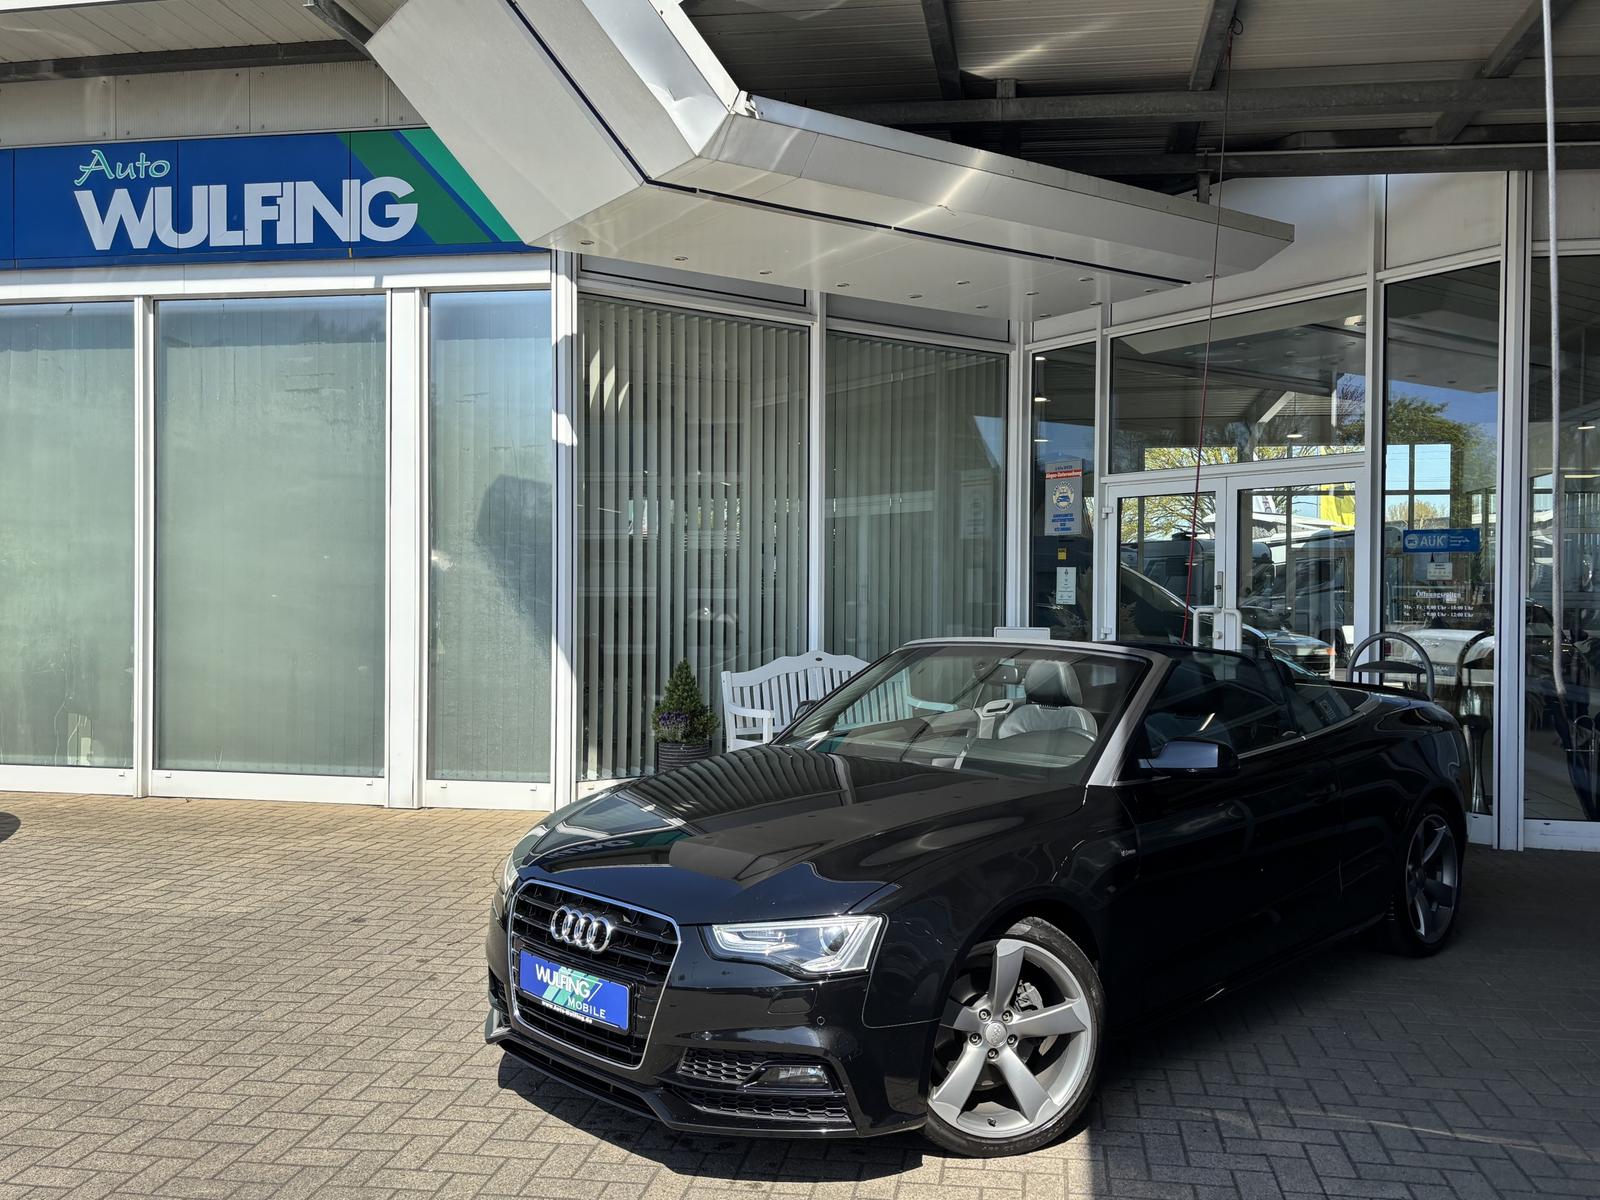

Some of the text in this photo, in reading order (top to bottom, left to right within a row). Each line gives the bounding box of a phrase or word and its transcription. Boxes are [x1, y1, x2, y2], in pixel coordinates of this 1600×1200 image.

[74, 149, 170, 186] Auto
[74, 176, 418, 251] WULFING
[536, 964, 590, 999] WULFING
[568, 996, 606, 1019] MOBILE
